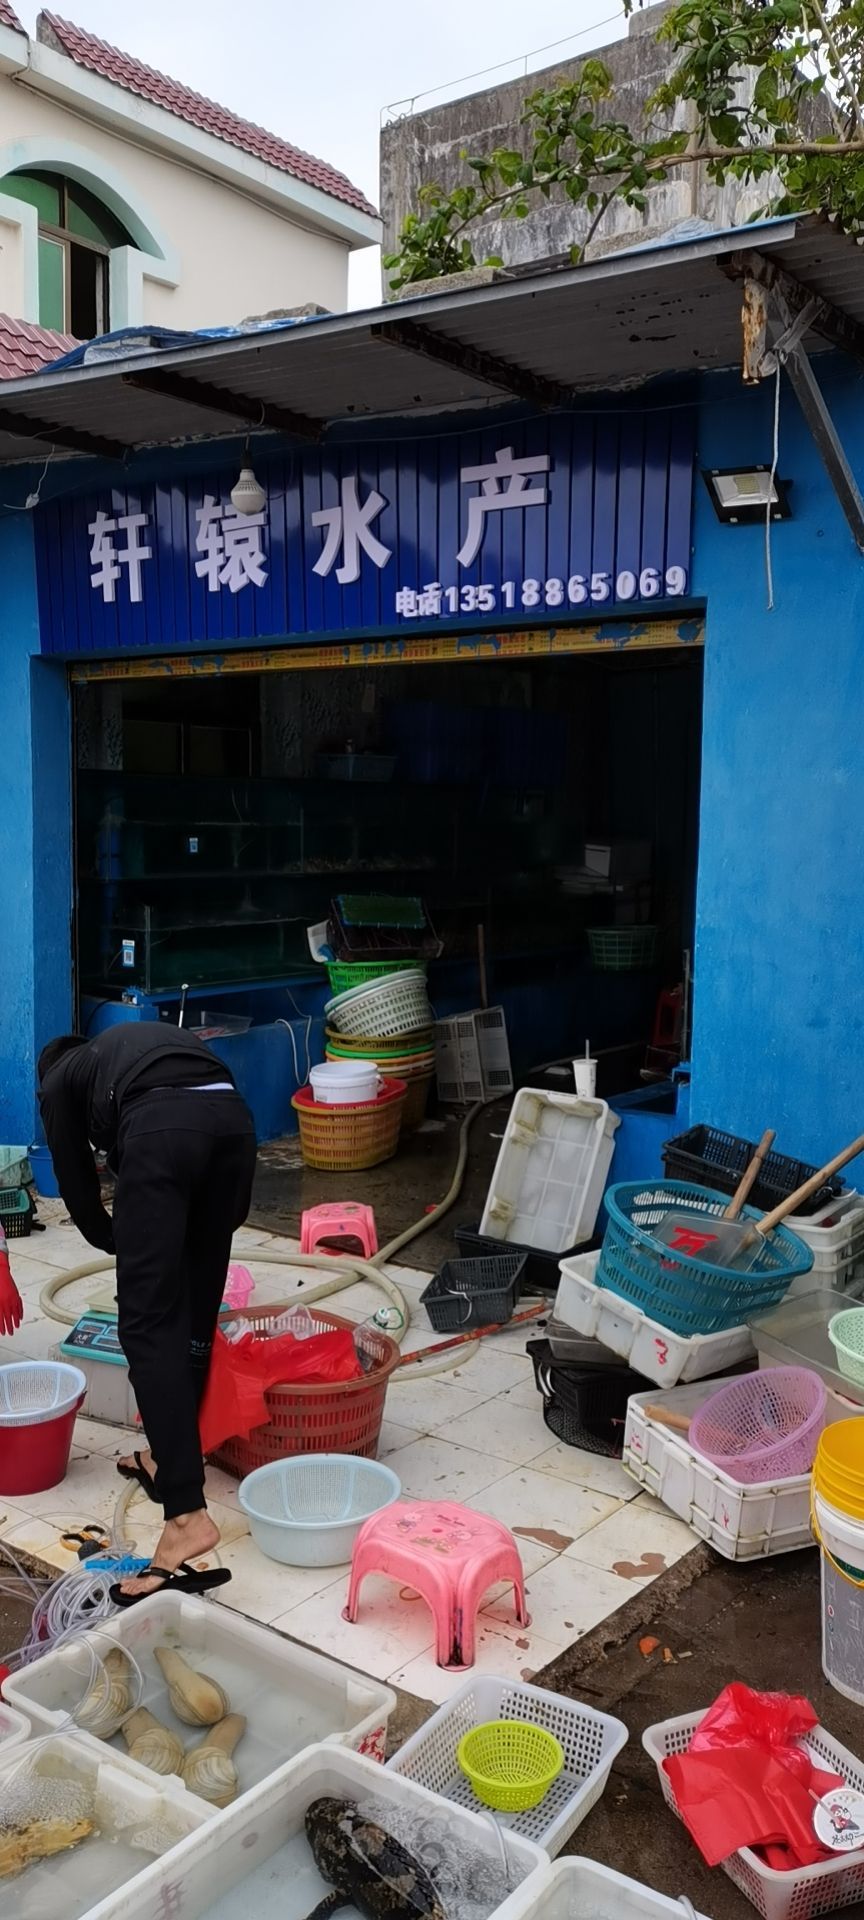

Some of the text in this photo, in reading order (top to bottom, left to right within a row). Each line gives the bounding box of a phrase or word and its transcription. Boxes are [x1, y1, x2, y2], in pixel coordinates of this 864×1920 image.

[88, 446, 551, 602] 轩辕水产
[395, 565, 687, 618] 电话13518865069
